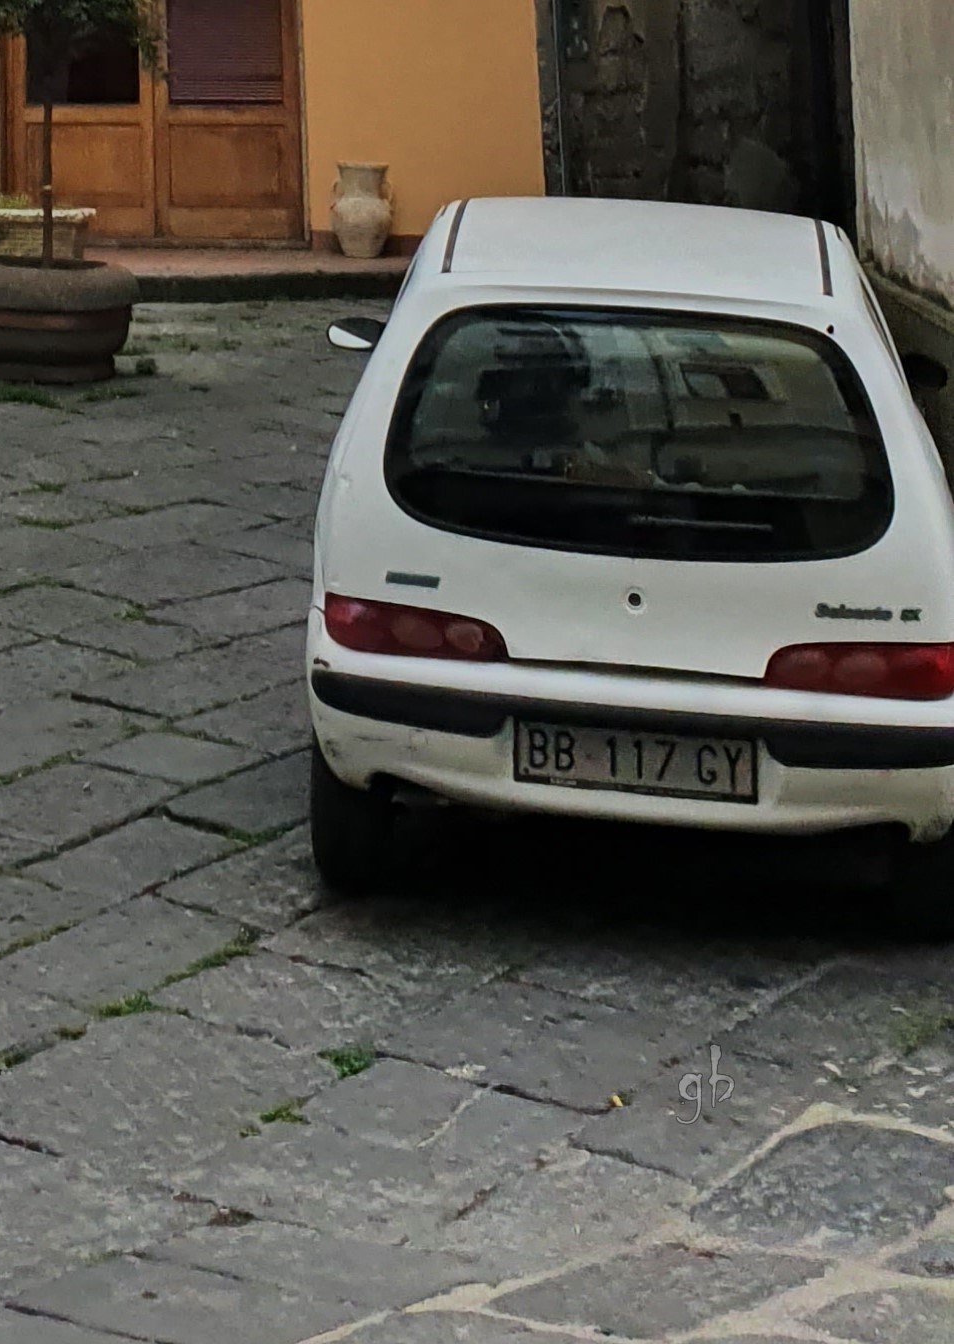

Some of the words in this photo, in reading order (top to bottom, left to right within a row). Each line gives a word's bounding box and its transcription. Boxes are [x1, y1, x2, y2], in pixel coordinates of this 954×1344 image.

[528, 727, 576, 772] BB
[606, 735, 677, 782] 117
[697, 744, 743, 793] GY
